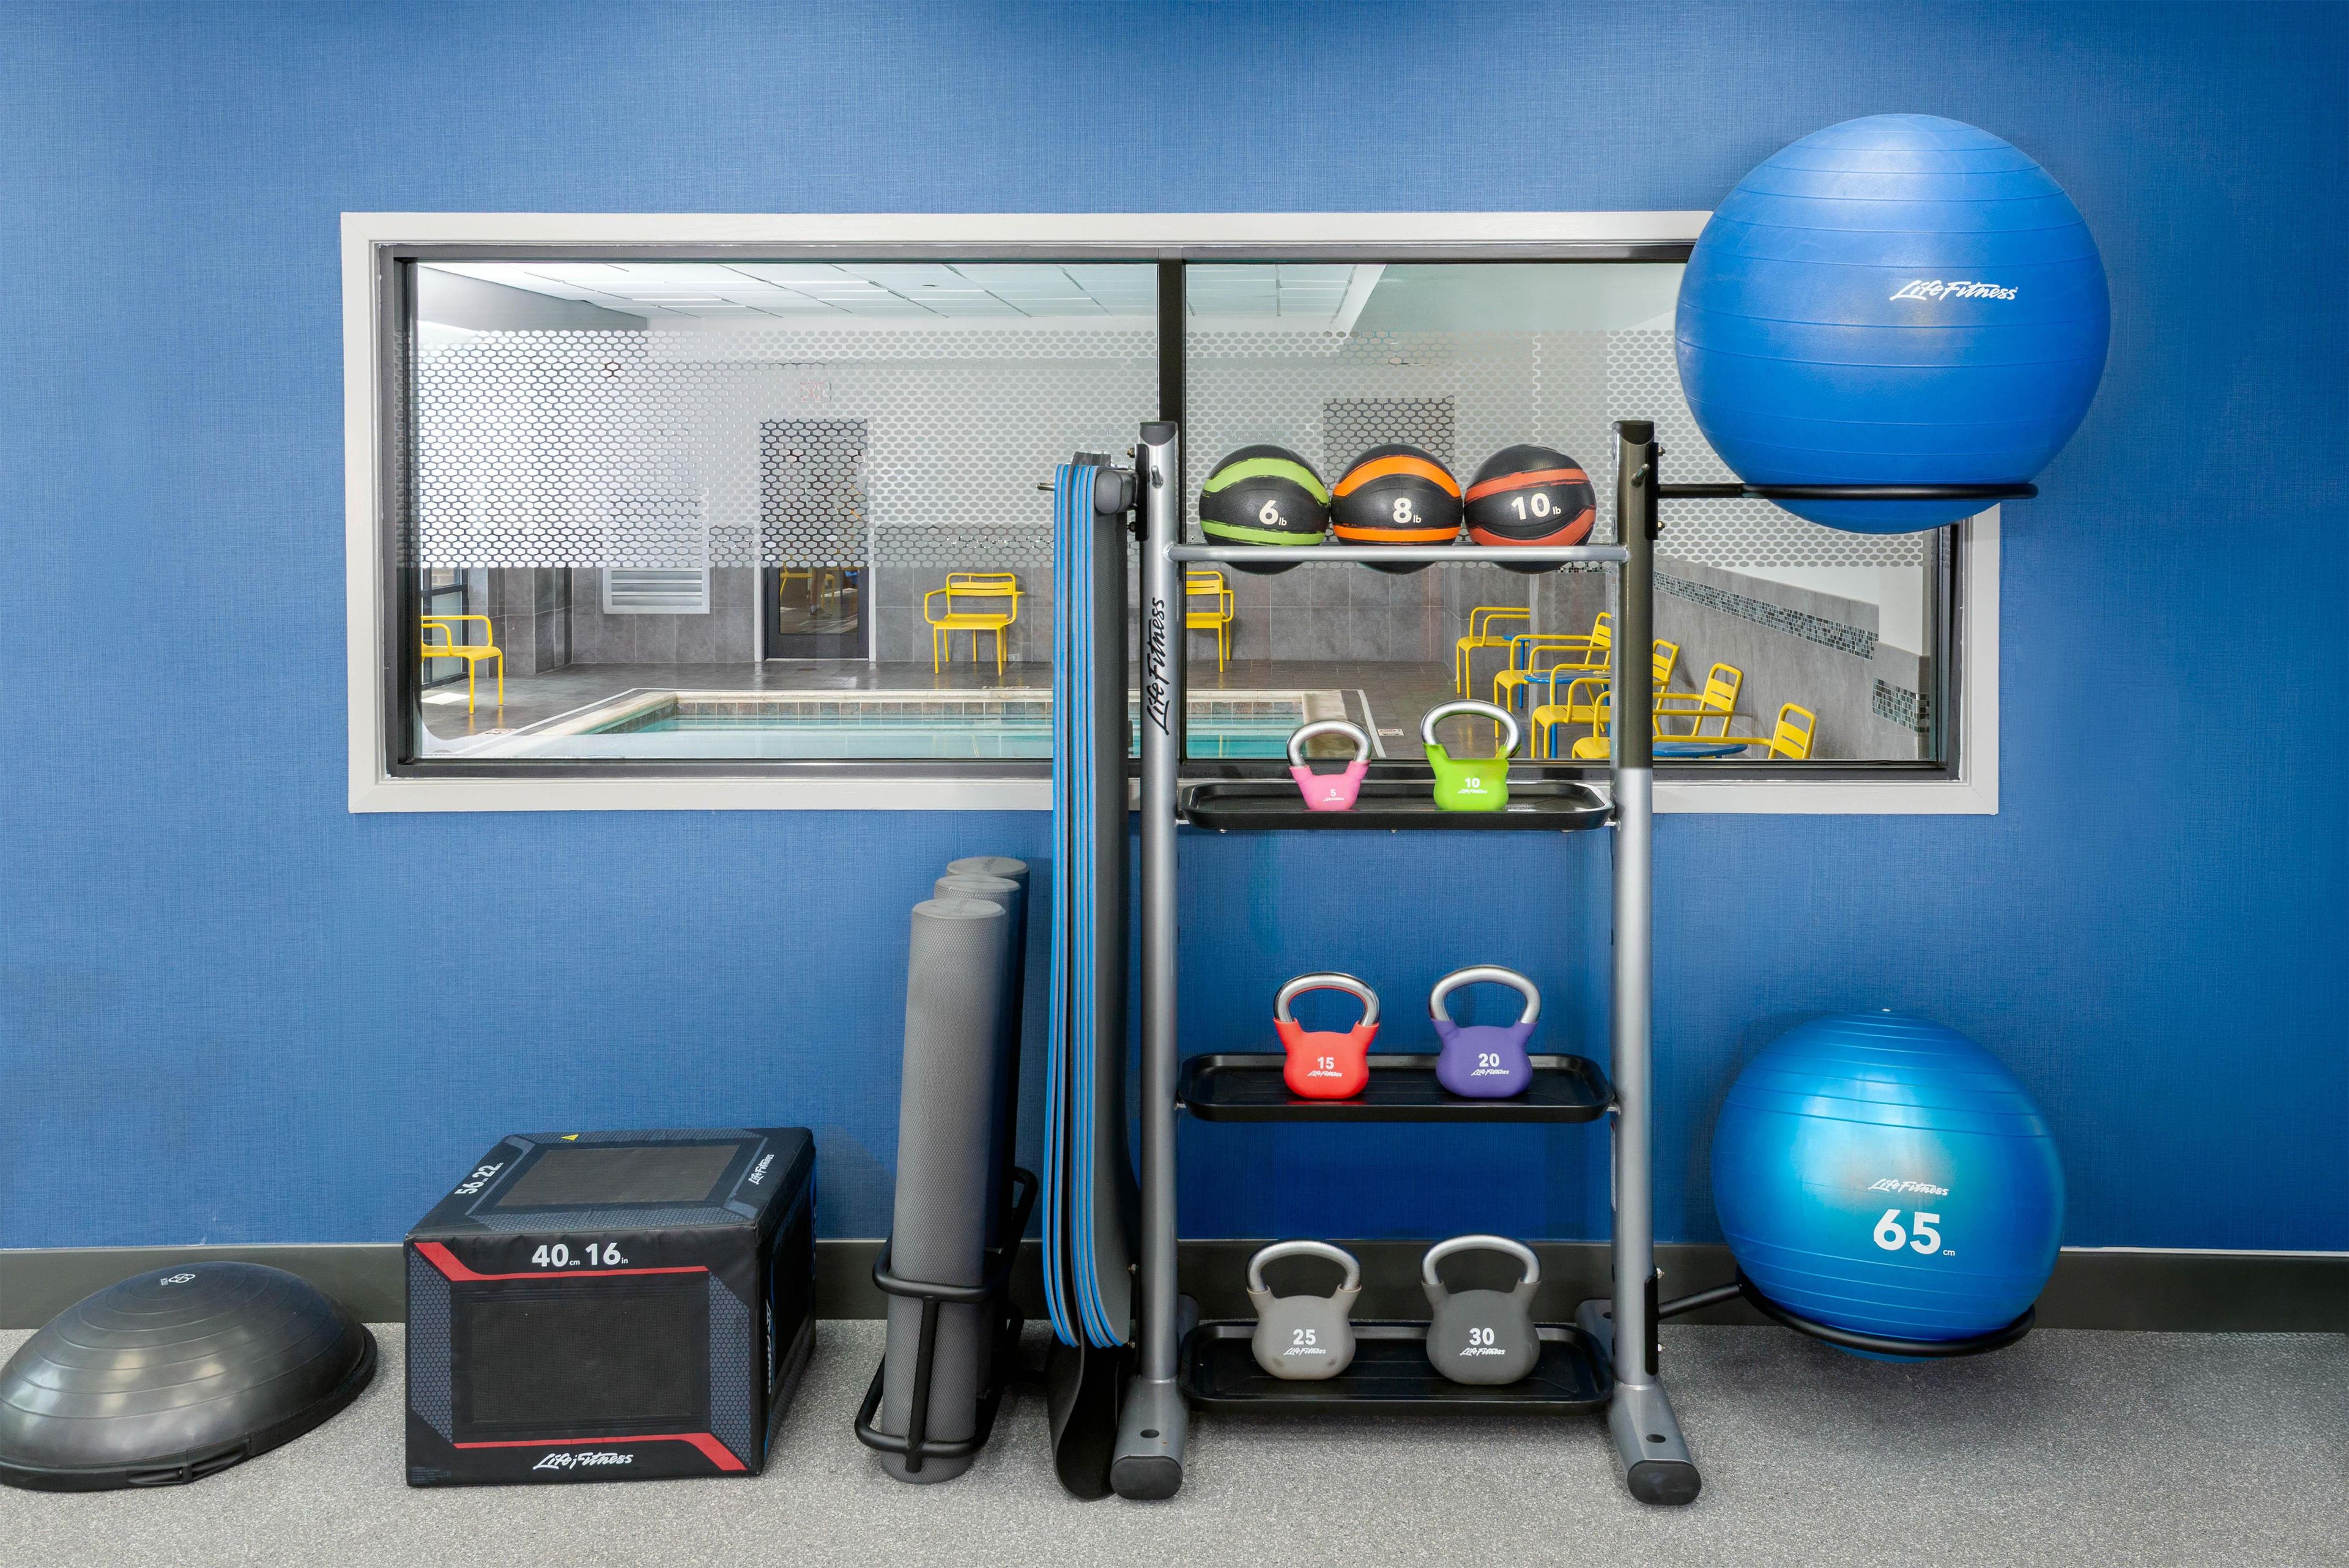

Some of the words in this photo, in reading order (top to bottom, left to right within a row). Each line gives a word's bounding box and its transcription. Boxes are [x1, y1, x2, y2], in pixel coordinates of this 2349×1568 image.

[1464, 777, 1480, 788] 10
[1316, 1057, 1335, 1069] 15
[1478, 1053, 1500, 1068] 20
[1293, 1328, 1316, 1345] 25
[1469, 1327, 1495, 1345] 30
